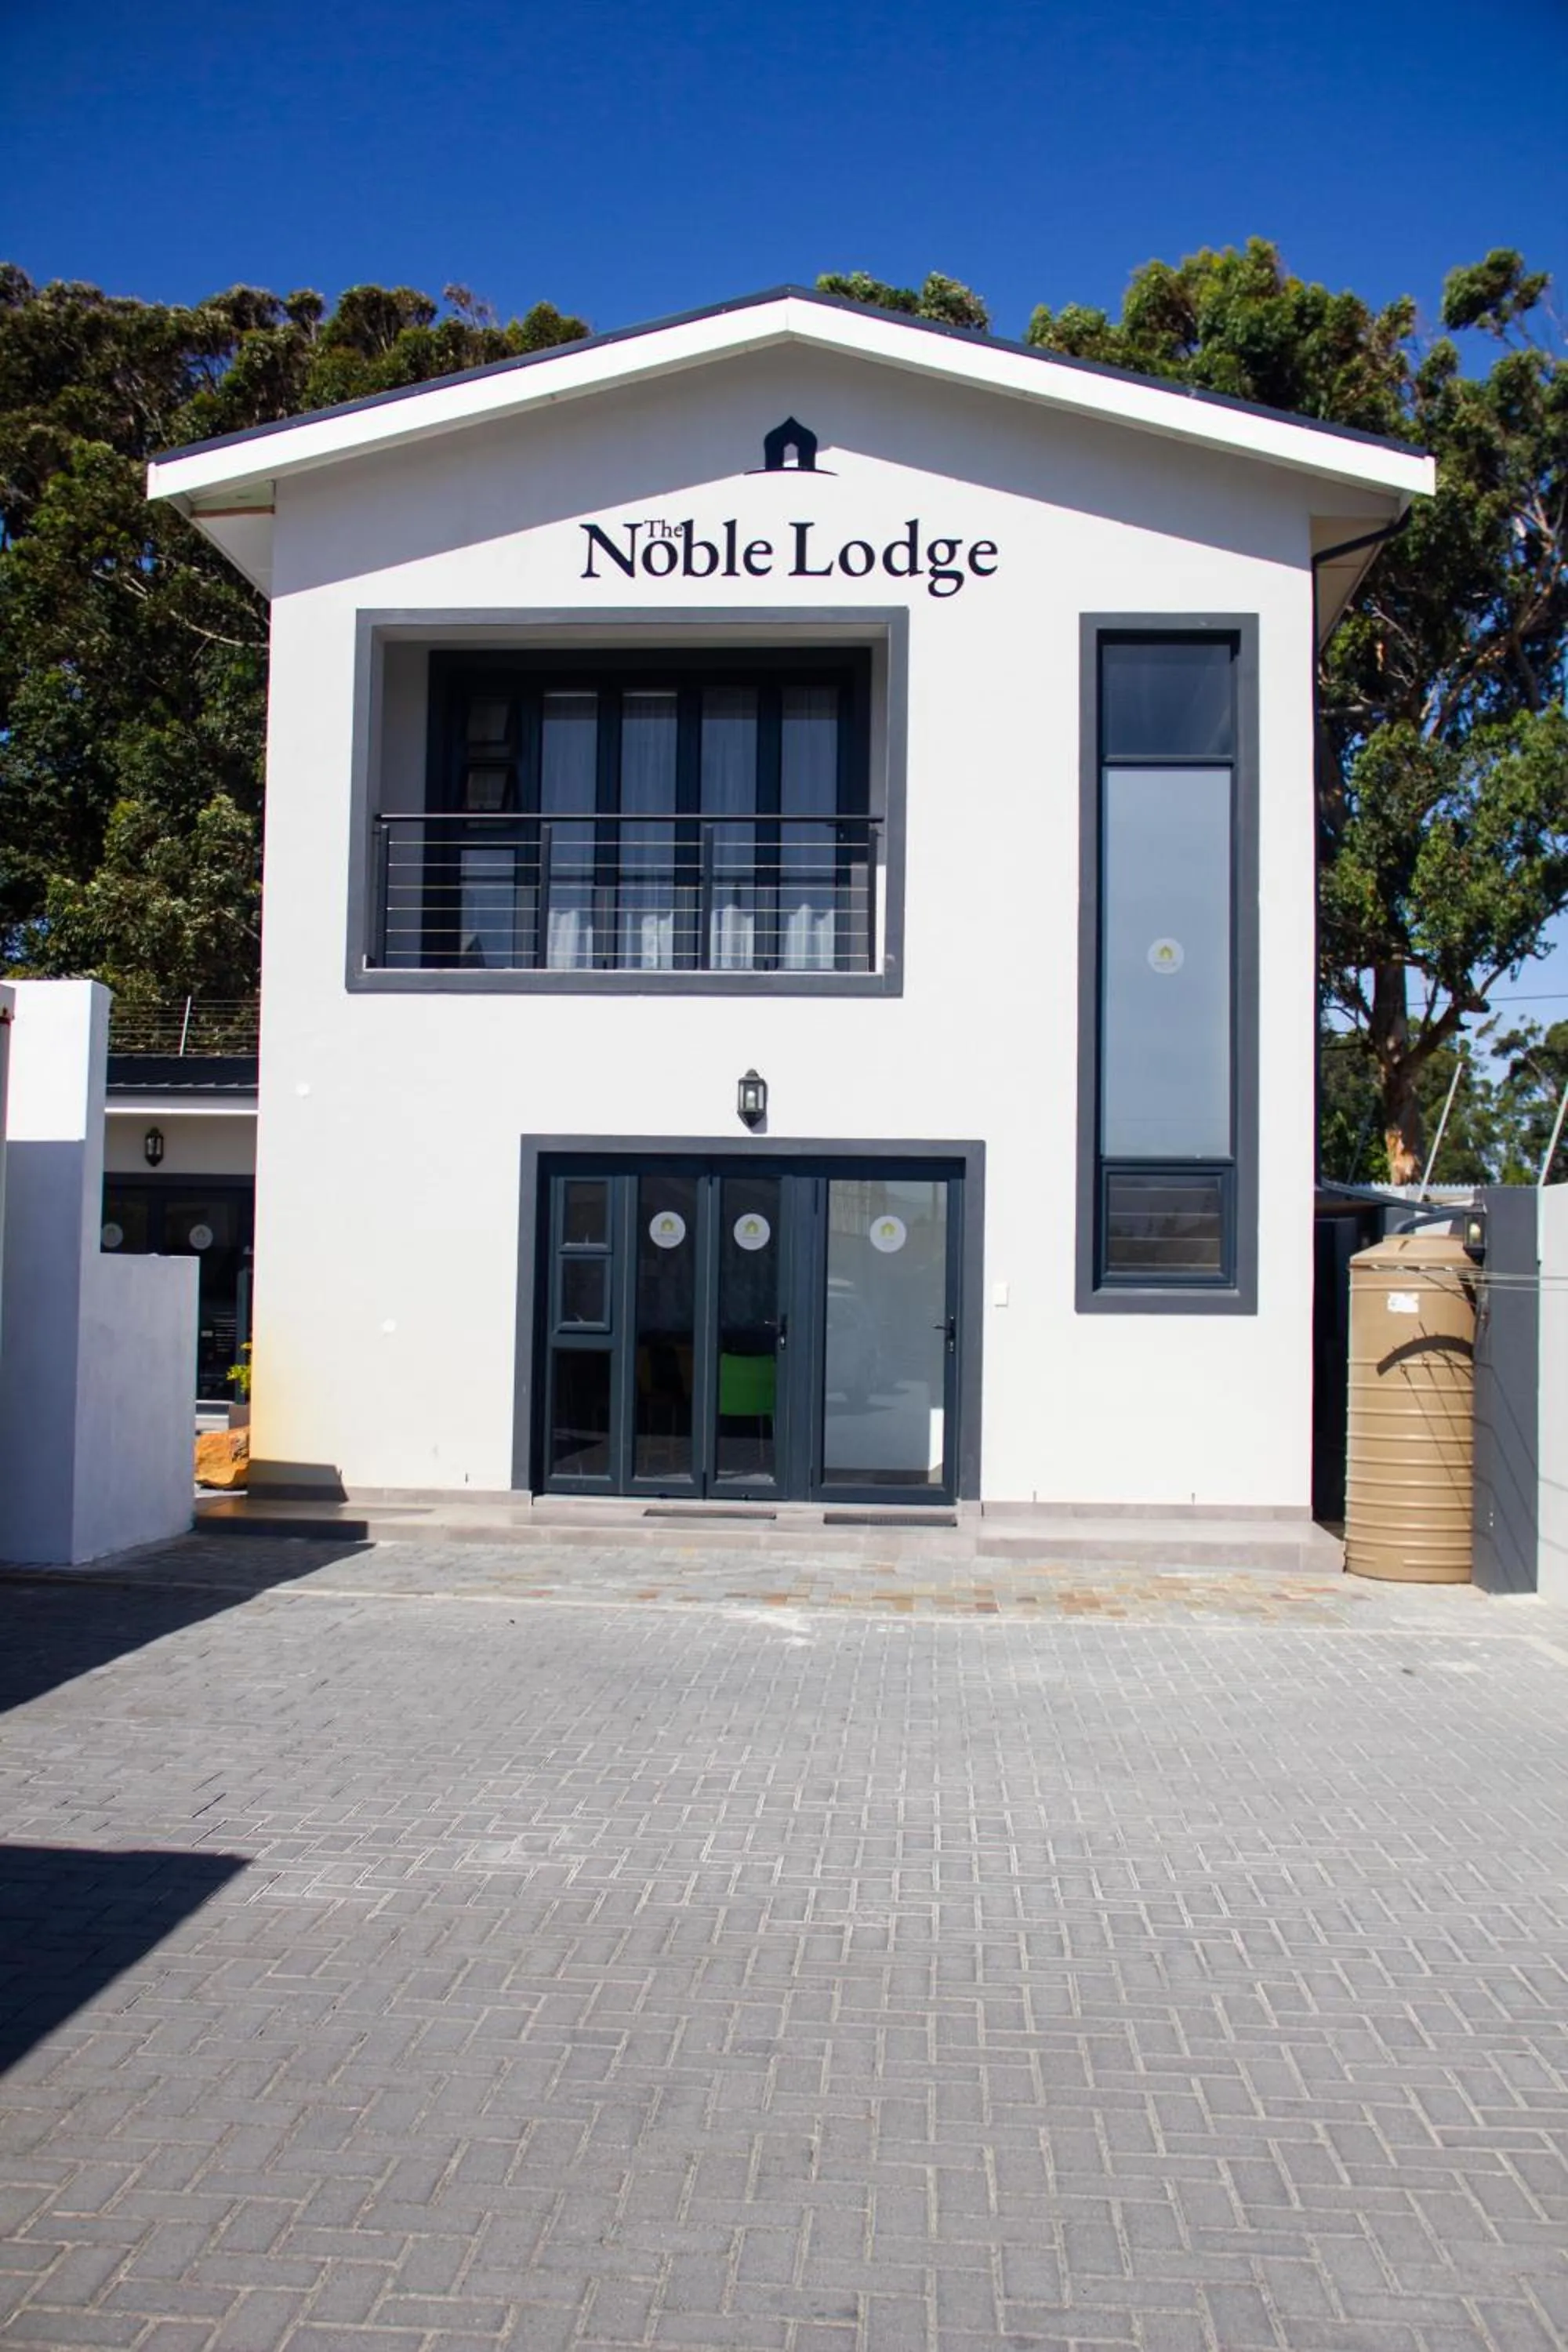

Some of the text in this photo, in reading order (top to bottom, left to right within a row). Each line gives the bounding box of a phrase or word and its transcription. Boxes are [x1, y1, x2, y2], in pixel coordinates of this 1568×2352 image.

[644, 519, 683, 539] The
[579, 517, 999, 598] Noble Lodge
